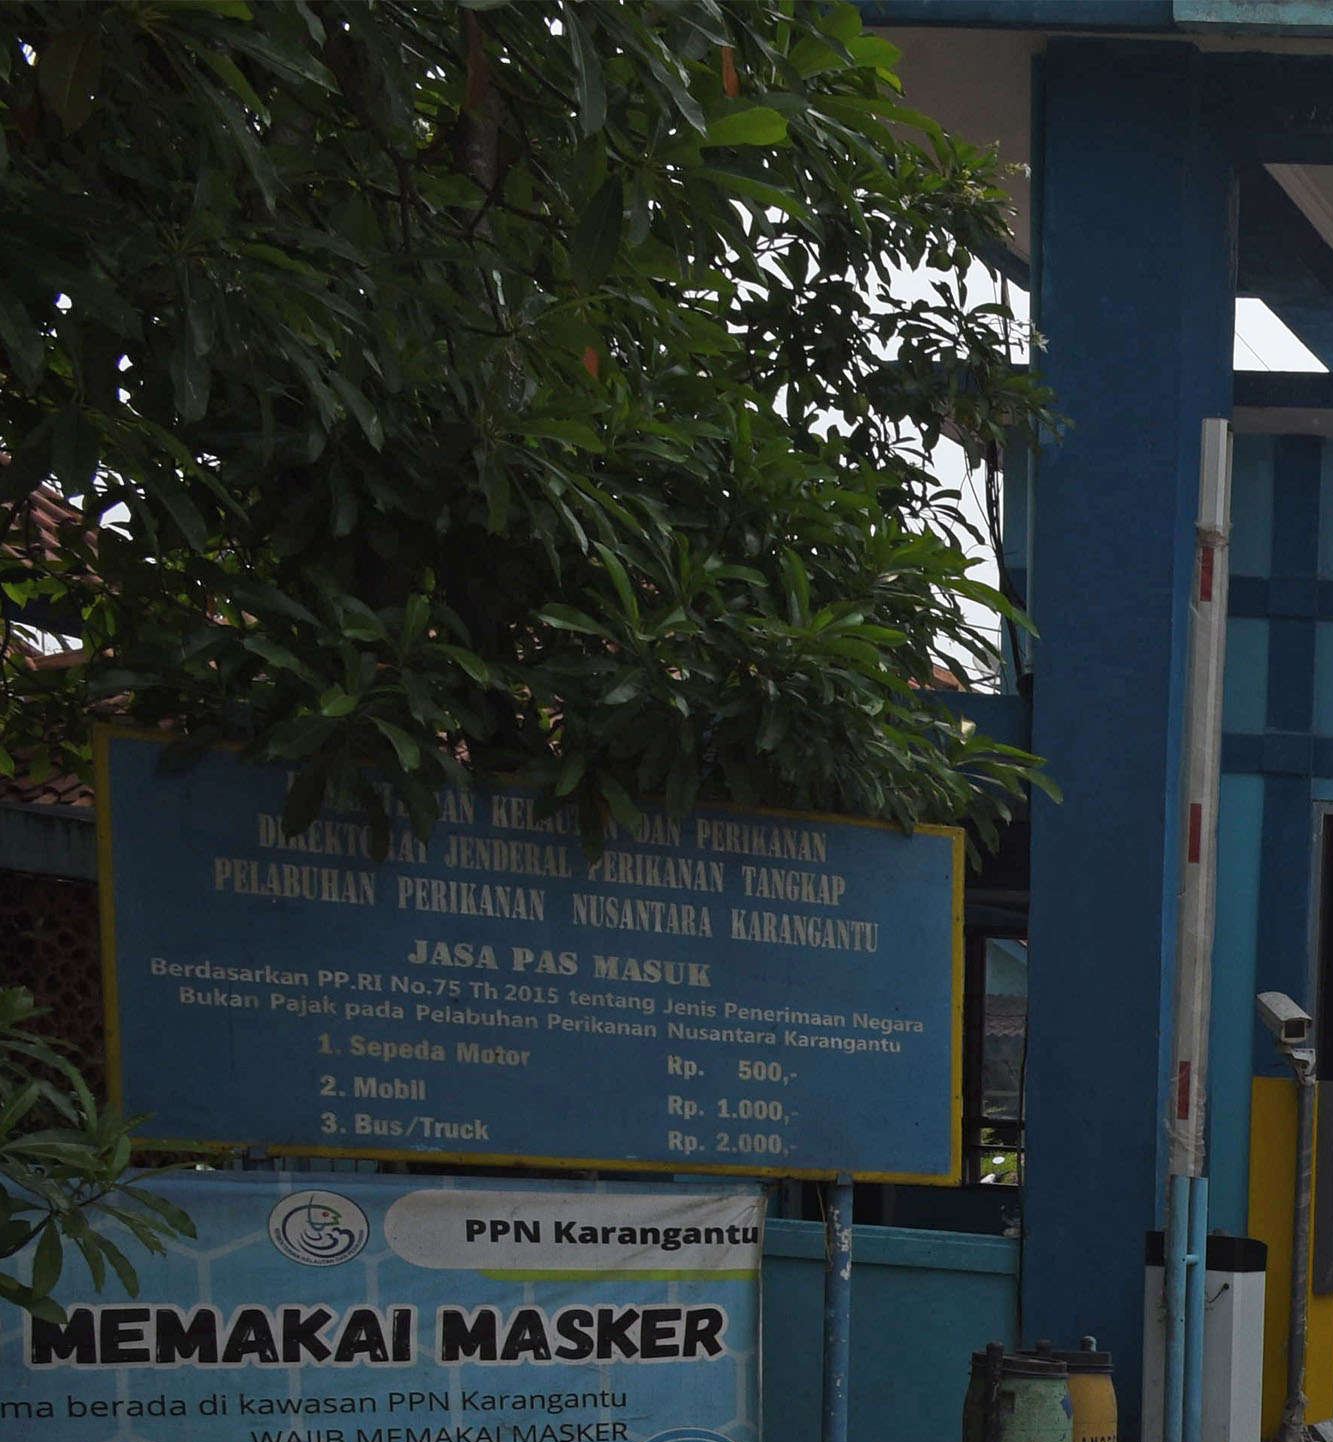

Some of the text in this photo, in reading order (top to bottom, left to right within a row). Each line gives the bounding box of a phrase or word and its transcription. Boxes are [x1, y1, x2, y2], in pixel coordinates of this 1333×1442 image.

[697, 818, 827, 864] PERIKANAN
[445, 834, 572, 879] JENDERAL
[742, 865, 846, 907] TANGKAP
[214, 858, 880, 953] PELABUHAN PERIKANAN NUSANTARA KARANGANTU
[408, 938, 712, 987] JASA PAS MASUK
[150, 956, 924, 1036] Berdasarkan PP.RI No.75 Th 2015 tentang Jenis Penerimaan Negara
[179, 986, 902, 1055] Bukan Pajak pada Pelabuhan Perikanan Nusantara Karangantu
[318, 1033, 531, 1067] 1. Sepeda Motor
[667, 1054, 798, 1085] Rp. 500,-
[320, 1075, 428, 1101] 2. Mobil
[321, 1111, 490, 1140] 3. Bus/Truck
[667, 1095, 799, 1125] Rp. 1.000,-
[667, 1130, 797, 1156] Rp. 2.000,-
[465, 1218, 759, 1251] PPN Karangantu
[31, 1307, 724, 1363] MEMAKAI MASKER
[67, 1395, 187, 1418] berada
[200, 1394, 227, 1416] di
[240, 1393, 377, 1416] kawasan
[388, 1391, 450, 1412] PPN
[462, 1389, 627, 1415] Karangantu
